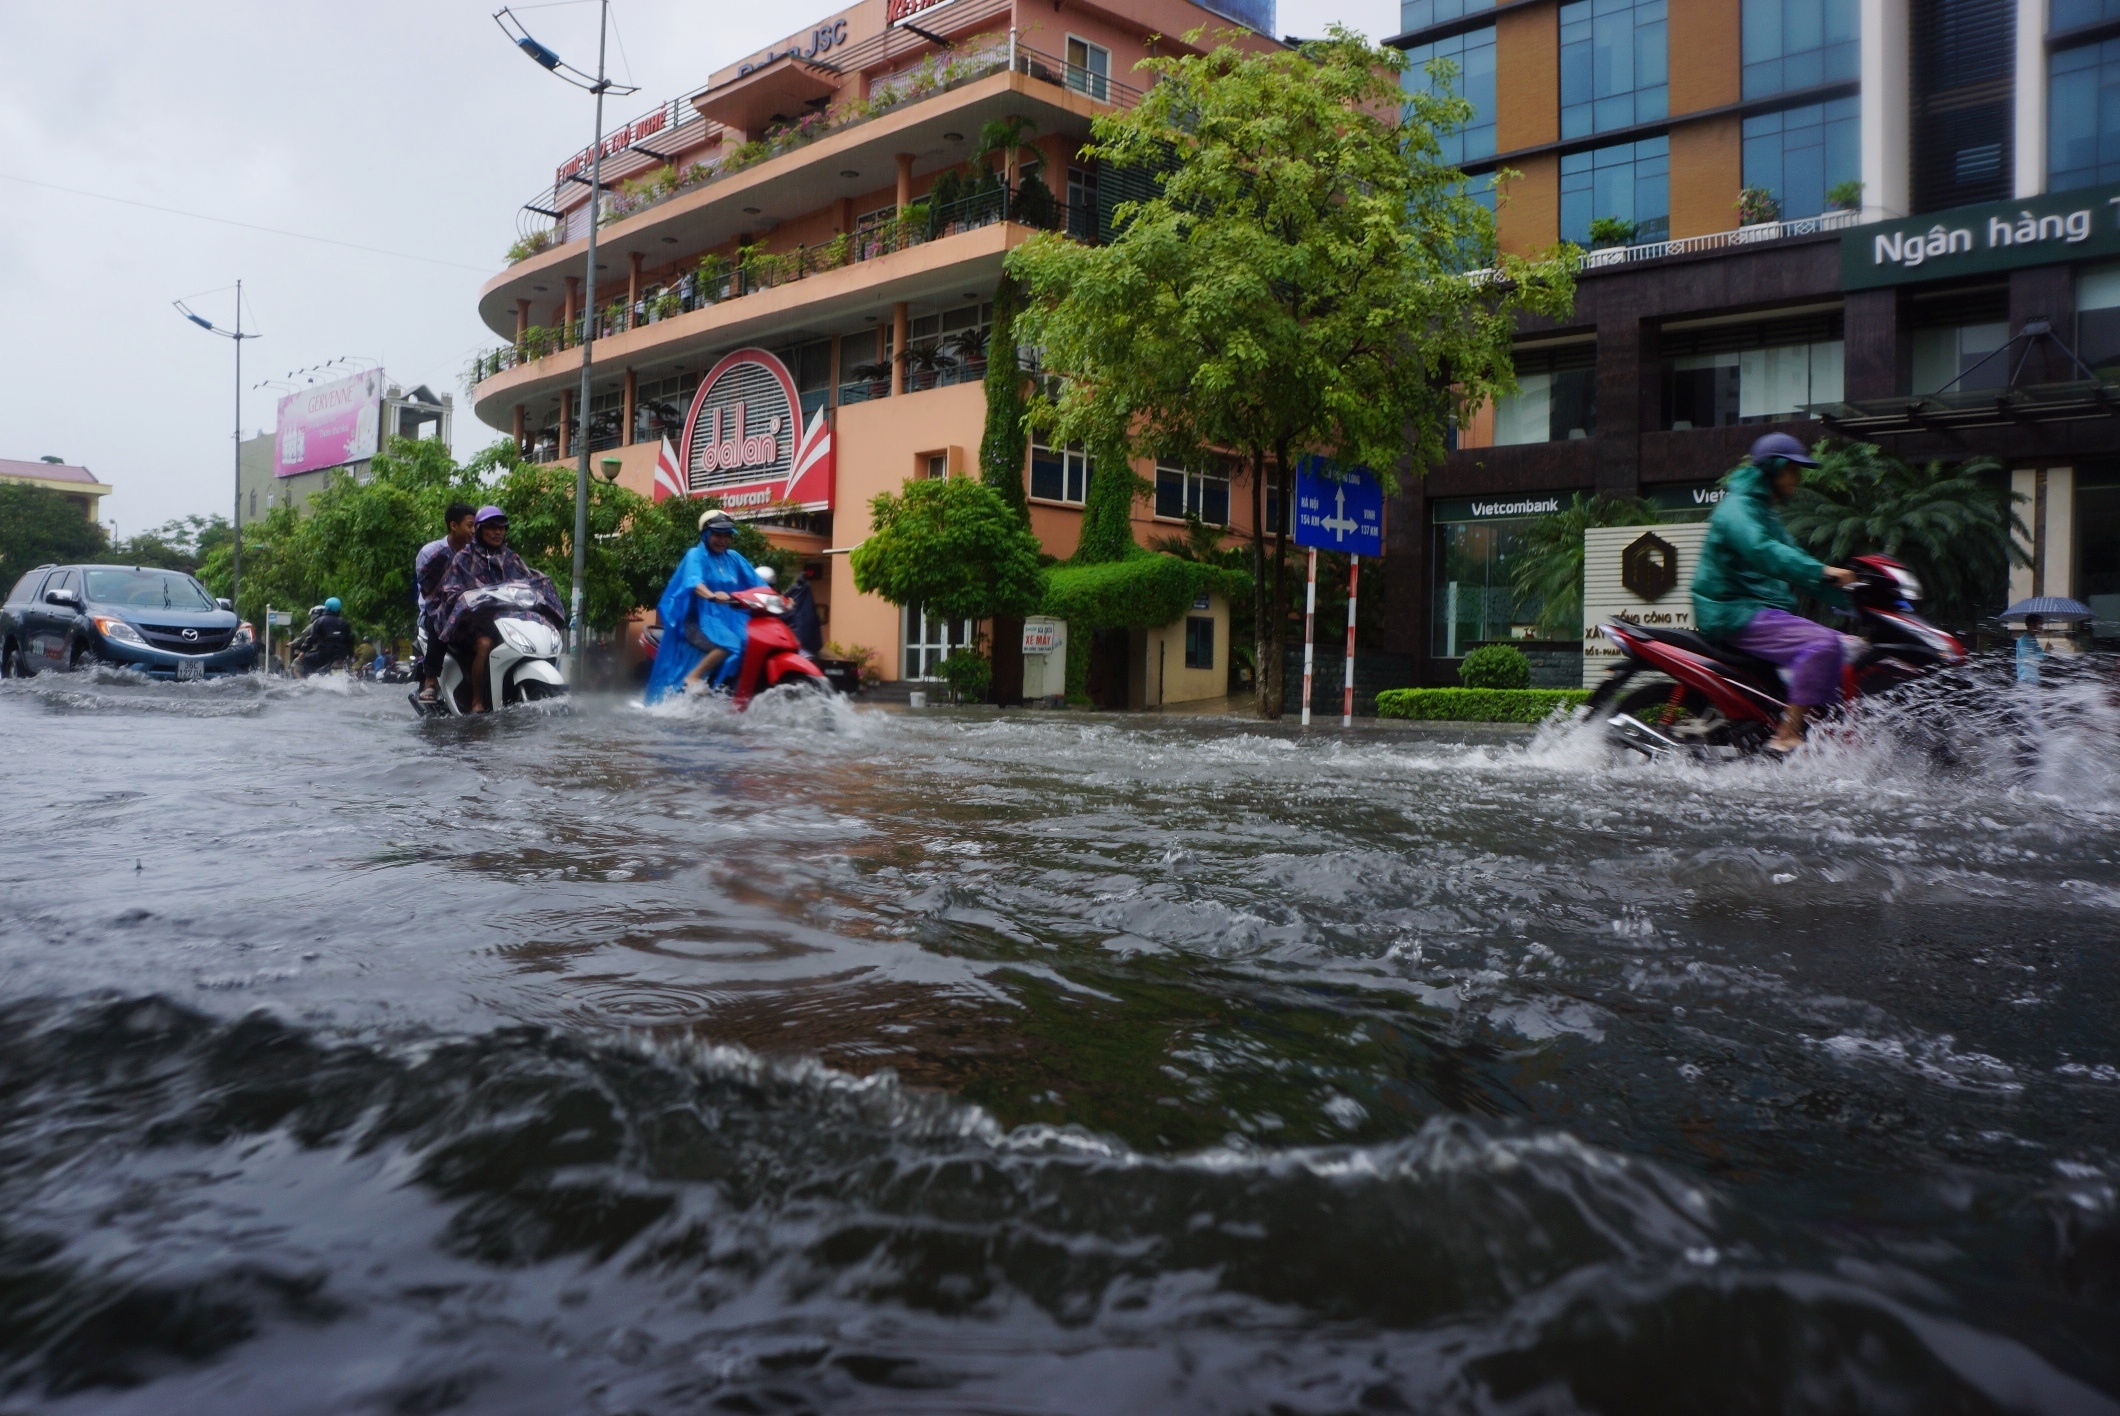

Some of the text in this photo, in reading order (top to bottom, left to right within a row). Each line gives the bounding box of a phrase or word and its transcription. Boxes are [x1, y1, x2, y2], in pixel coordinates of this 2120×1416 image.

[804, 18, 847, 59] JSC
[1874, 224, 1973, 267] Ngân
[1989, 209, 2091, 248] hàng
[308, 384, 355, 413] GERVENNE
[701, 400, 777, 473] dalan
[1471, 497, 1559, 517] Vietcombank
[1643, 610, 1672, 624] CÔNG
[1675, 613, 1689, 623] TY
